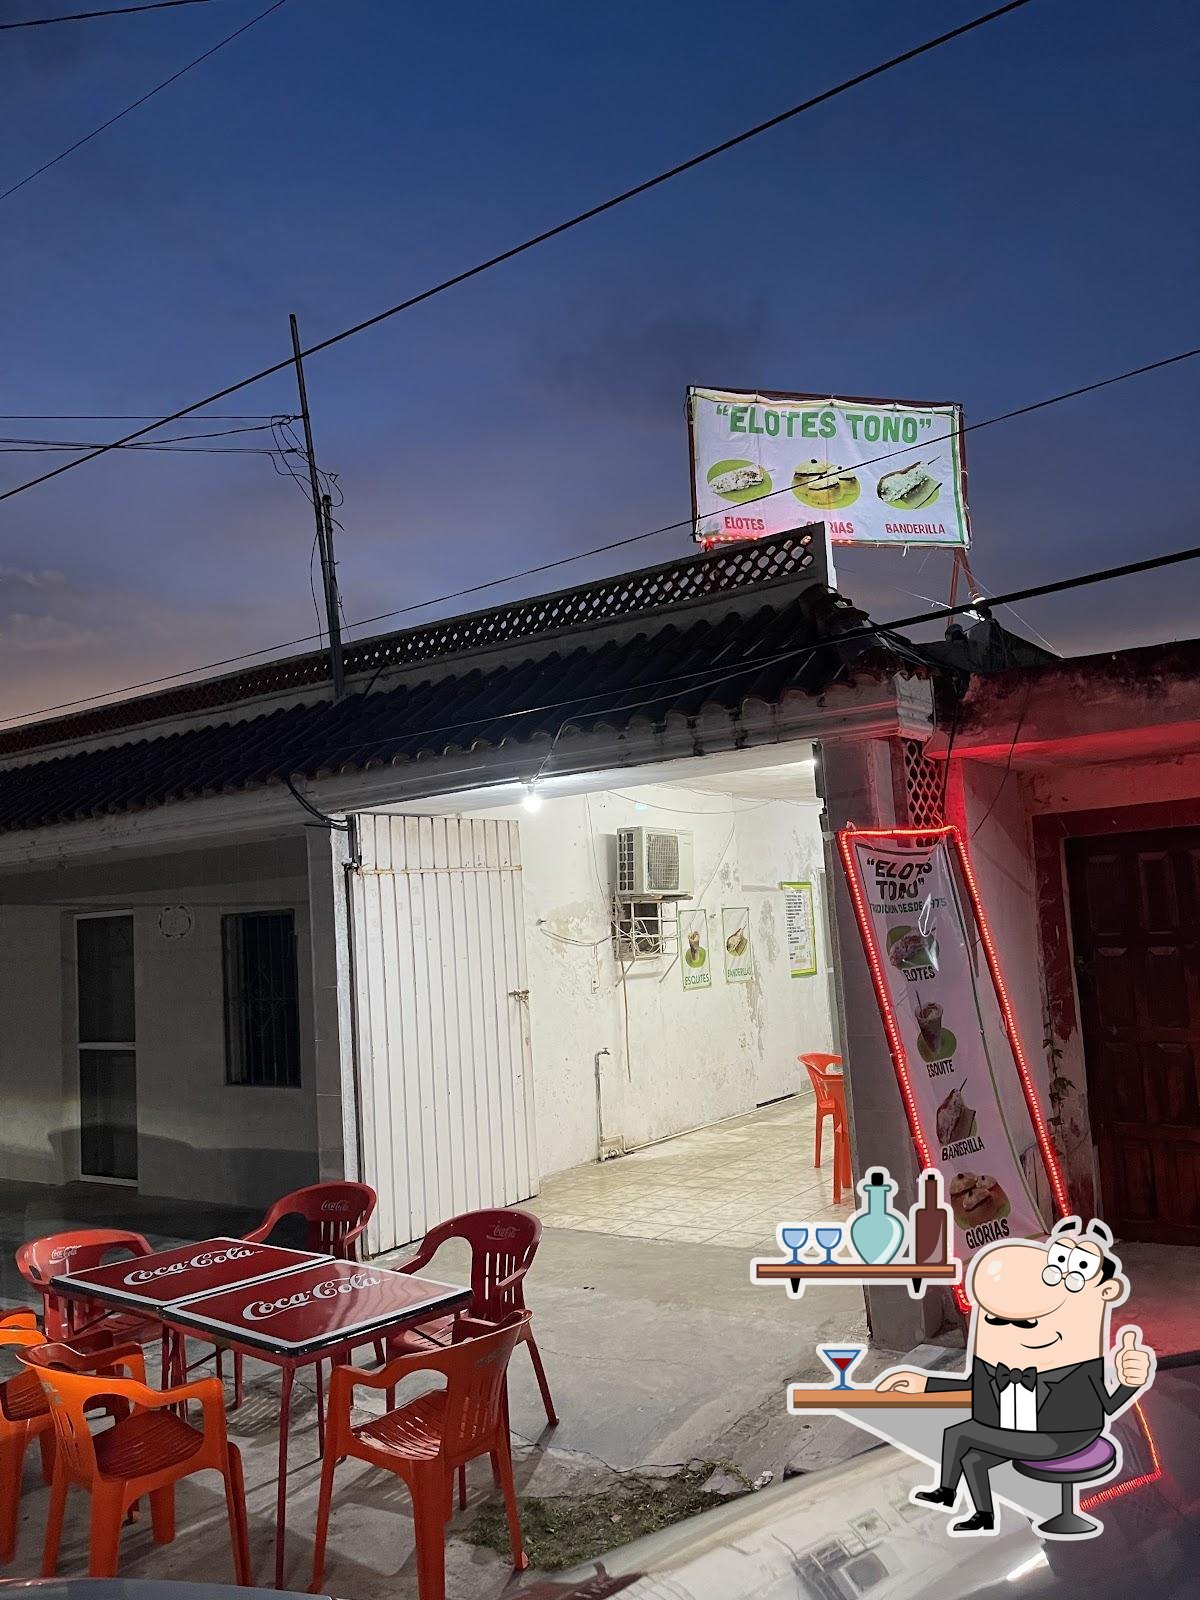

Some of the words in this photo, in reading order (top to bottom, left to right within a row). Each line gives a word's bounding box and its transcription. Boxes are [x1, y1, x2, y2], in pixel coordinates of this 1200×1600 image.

[724, 516, 765, 531] ELOTES
[806, 521, 854, 534] RIAS
[885, 522, 946, 535] BANDERILLA
[898, 901, 923, 914] DESDE
[684, 973, 710, 986] ESQUITES
[926, 1059, 954, 1078] ESQUITE
[942, 1136, 985, 1161] BANDERILLA
[965, 1218, 1010, 1250] GLORIAS
[123, 1246, 264, 1286] Coca-Cola
[242, 1272, 392, 1321] Coca-Cola
